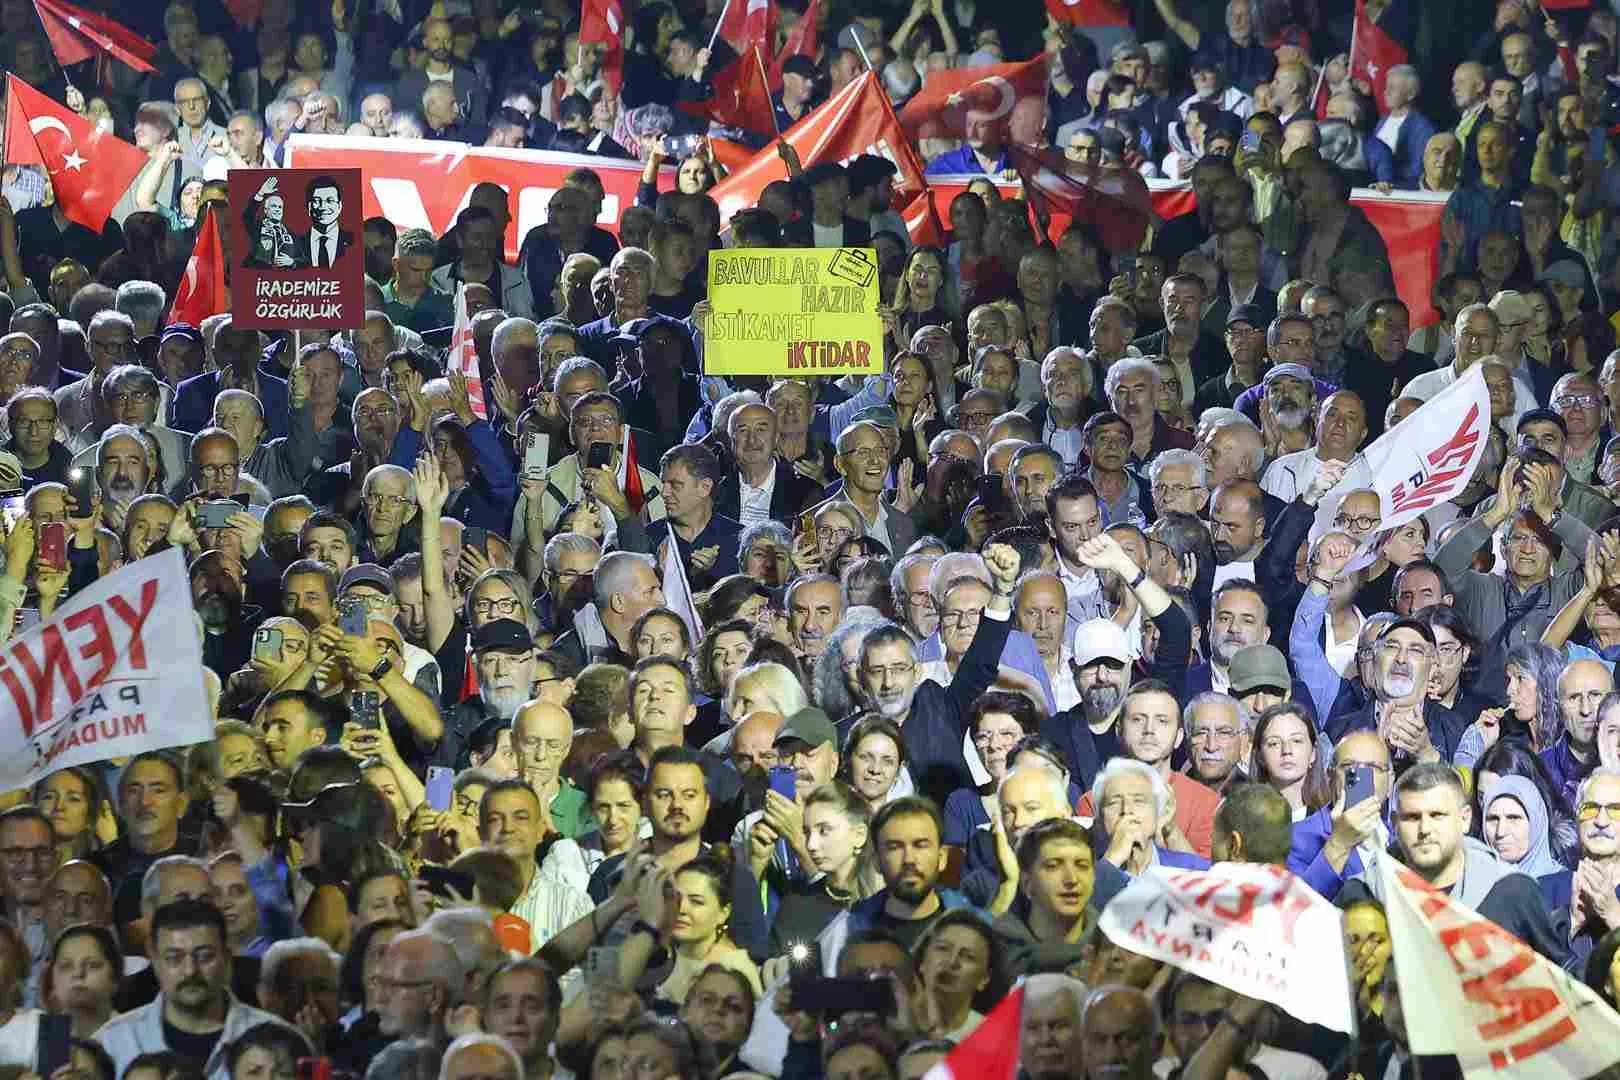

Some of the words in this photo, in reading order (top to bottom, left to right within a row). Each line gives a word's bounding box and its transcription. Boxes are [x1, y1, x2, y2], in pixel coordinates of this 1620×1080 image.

[714, 256, 820, 286] BAVULLAR
[256, 277, 341, 297] İRADEMİZE
[801, 285, 866, 313] HAZIR
[255, 299, 342, 320] ÖZGÜRLÜK
